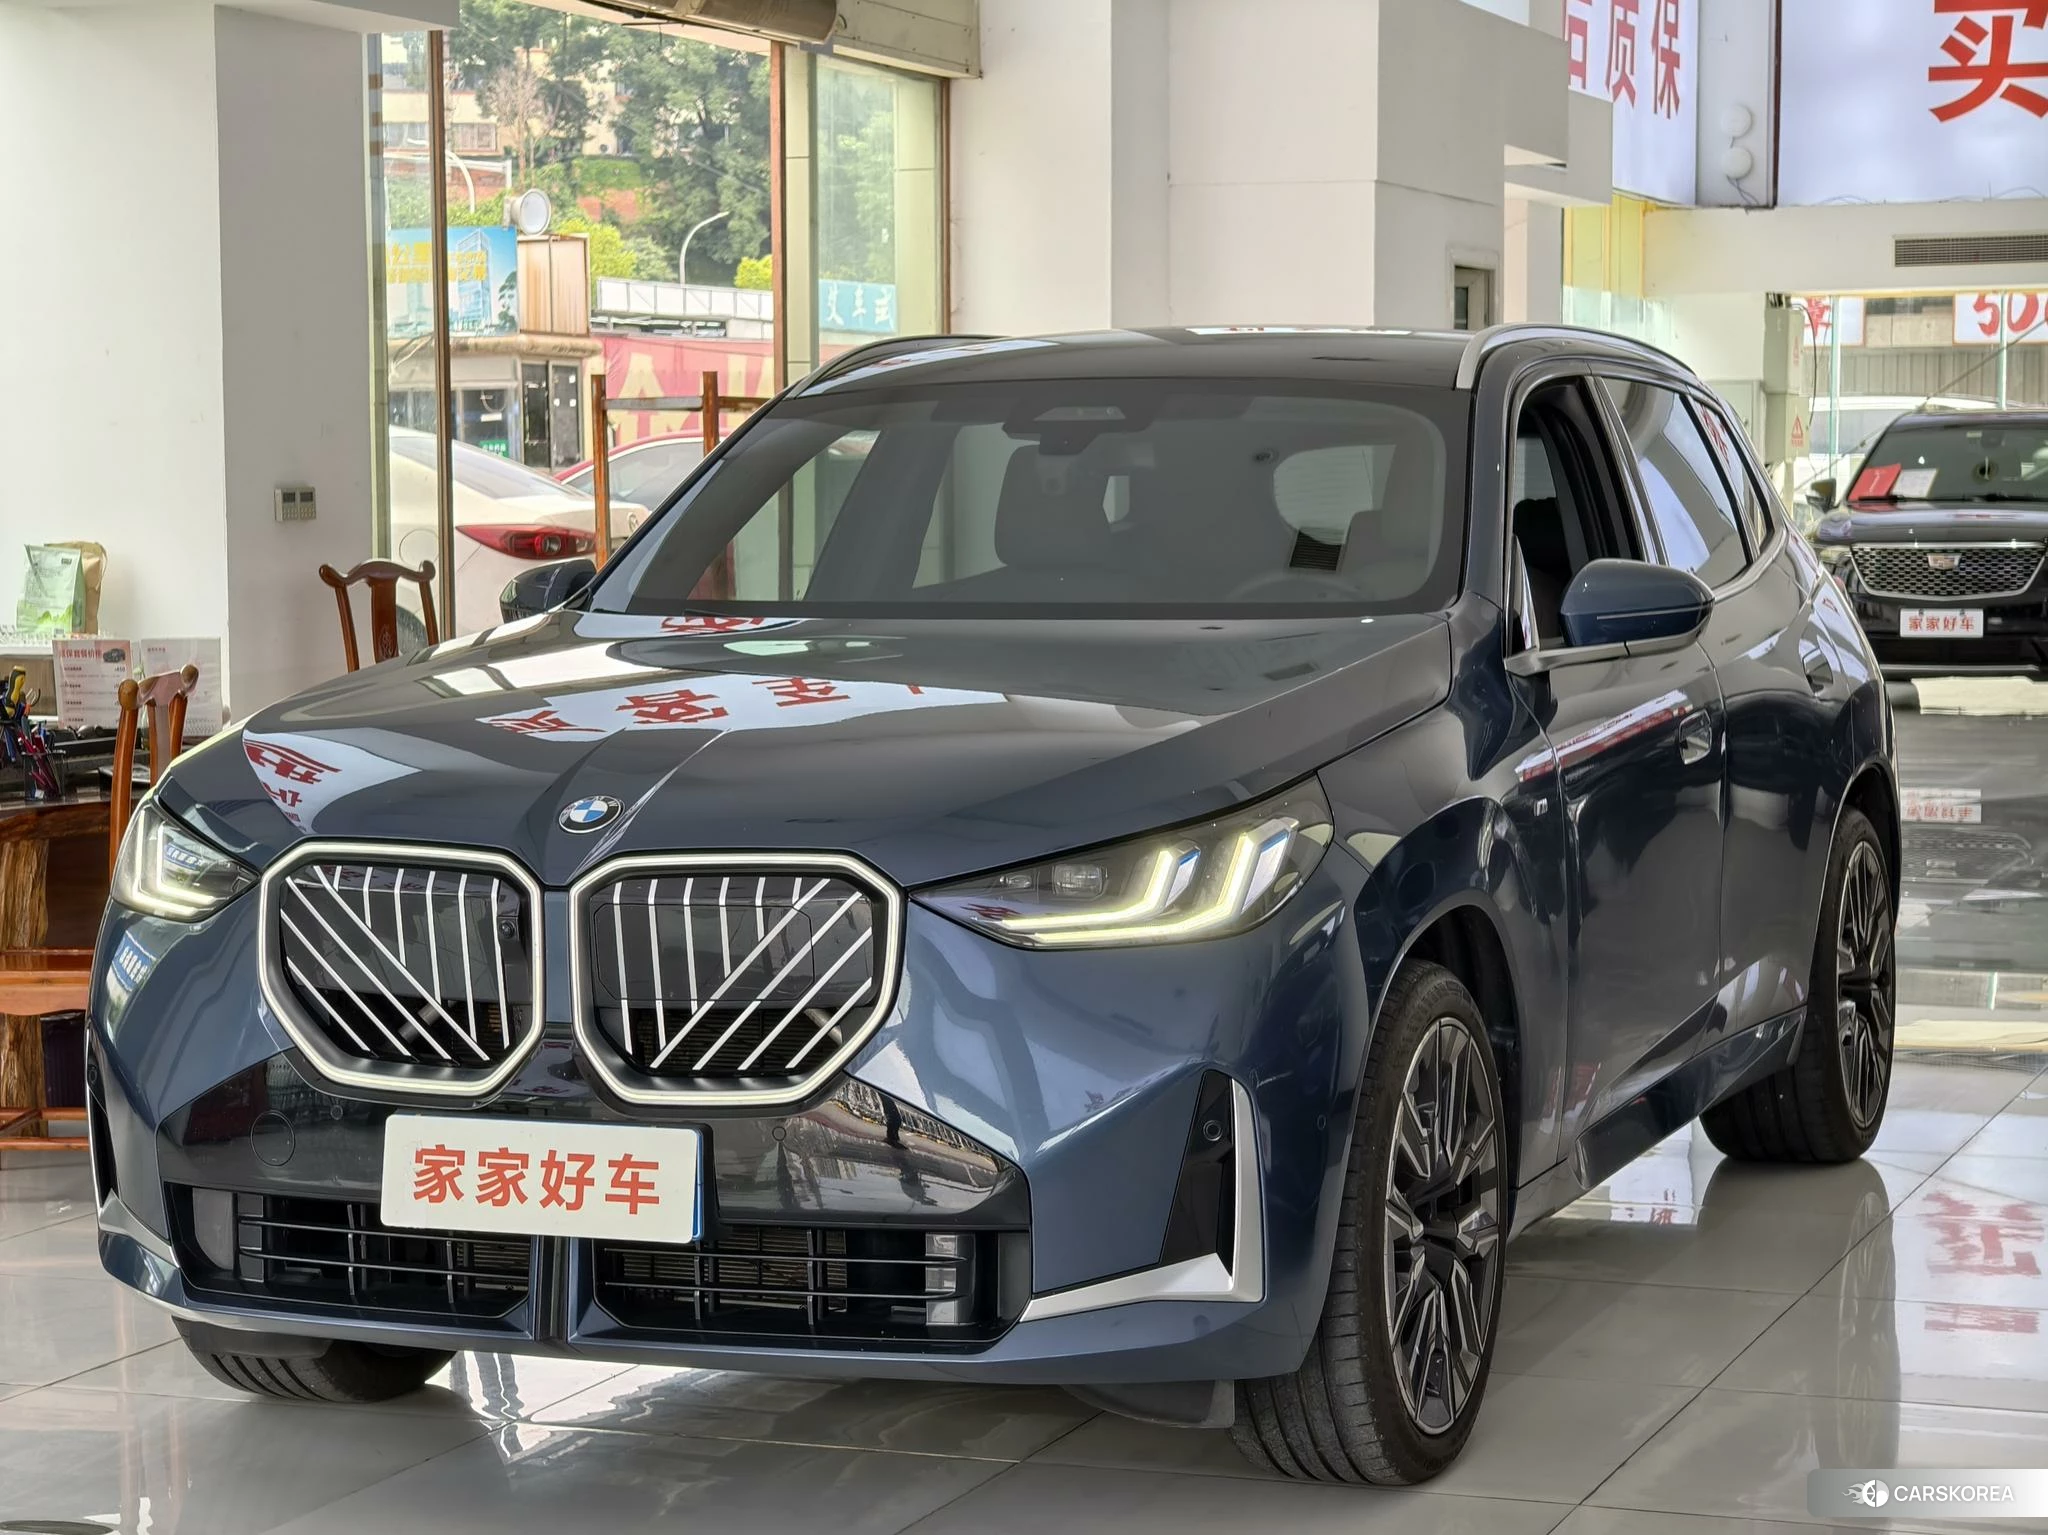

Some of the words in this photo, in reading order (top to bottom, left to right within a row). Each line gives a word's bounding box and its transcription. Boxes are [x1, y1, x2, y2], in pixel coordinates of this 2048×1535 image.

[1973, 292, 2048, 337] 50
[1908, 615, 1975, 632] 家家好车
[413, 1143, 660, 1215] 家家好车
